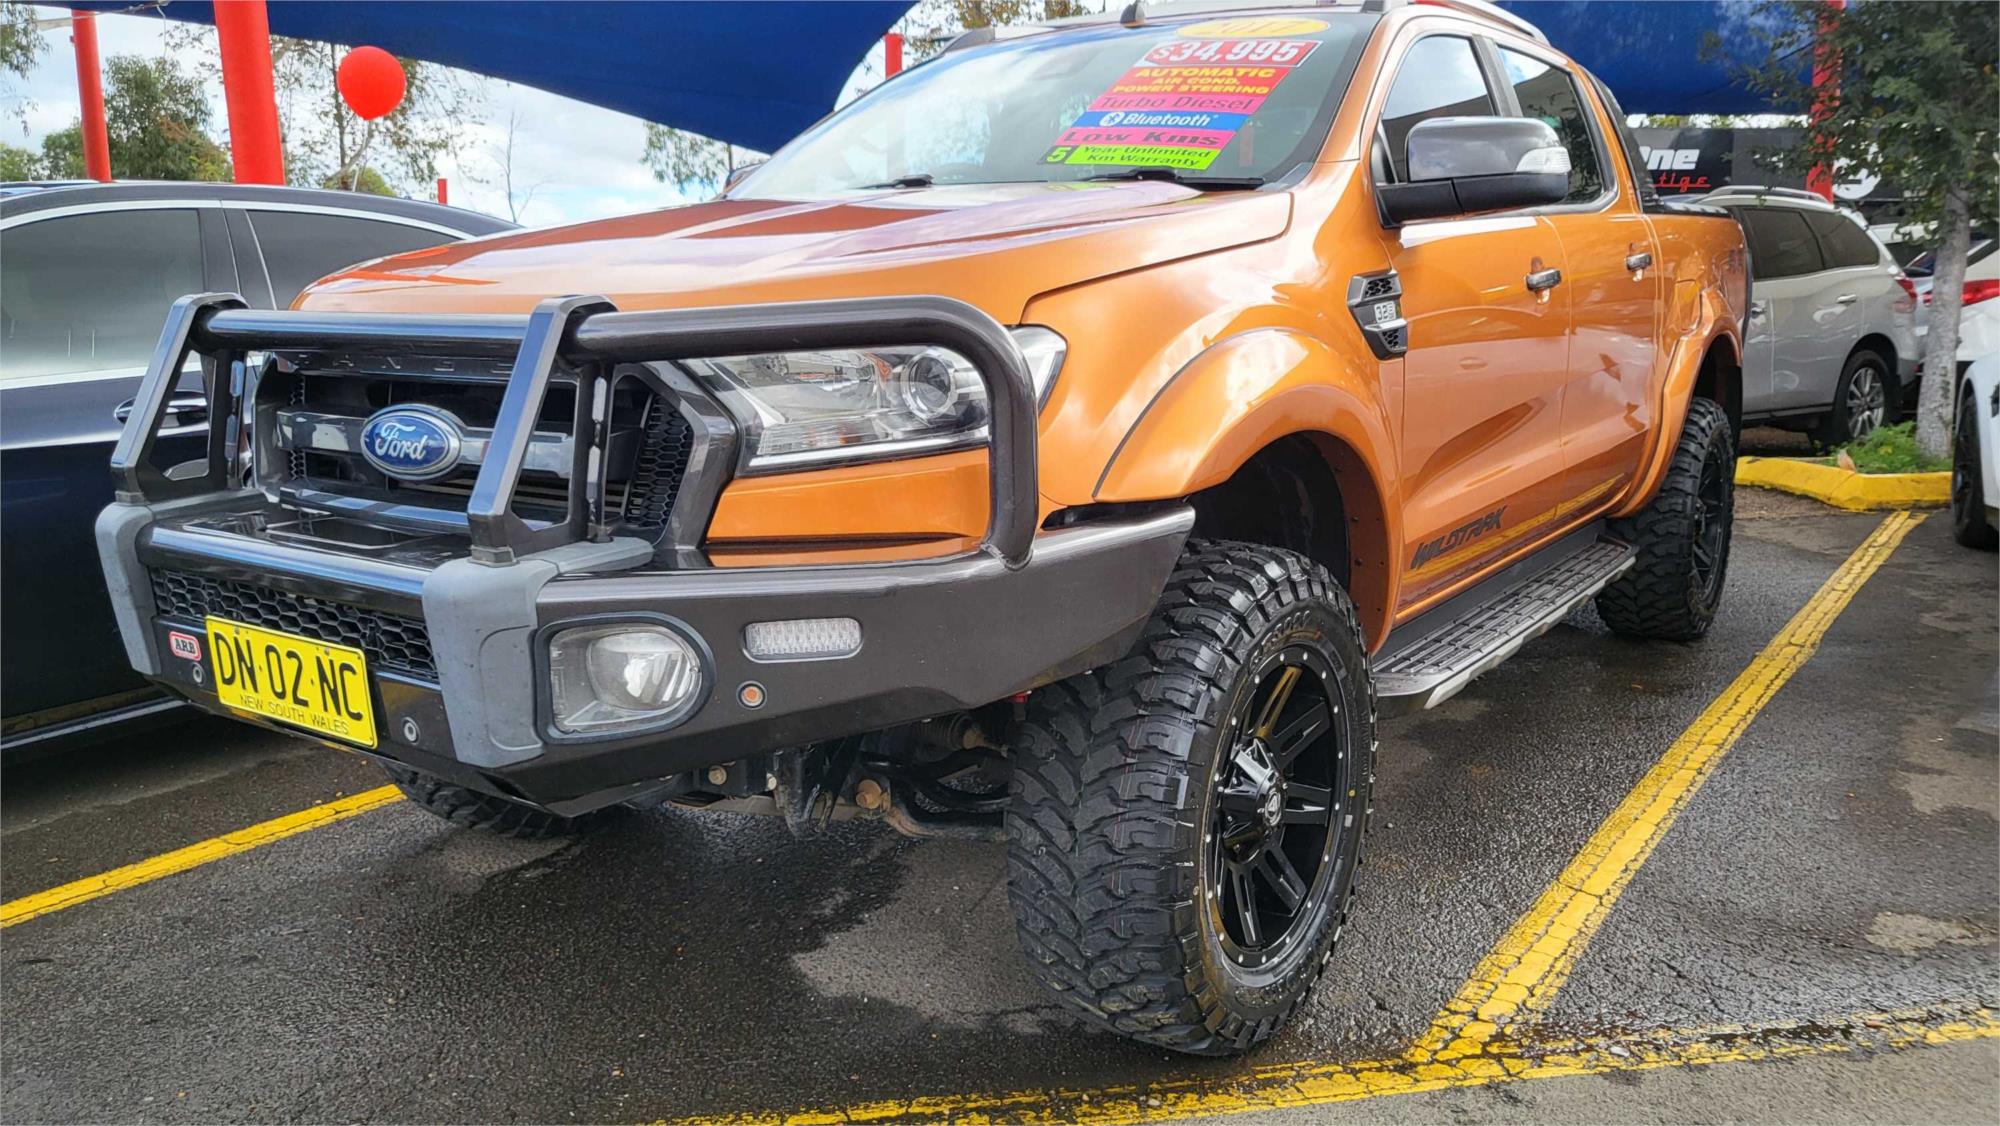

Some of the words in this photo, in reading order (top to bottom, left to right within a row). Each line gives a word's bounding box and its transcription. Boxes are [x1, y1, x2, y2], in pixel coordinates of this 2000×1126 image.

[1153, 41, 1306, 63] $34,995
[1135, 67, 1276, 78] AUTOMATIC
[1112, 85, 1174, 93] POWER
[1178, 85, 1269, 94] STEERING
[1101, 96, 1165, 108] Turbo
[1173, 96, 1254, 110] Diesel
[1122, 113, 1211, 127] Bluetooth
[1063, 131, 1131, 142] Low
[1142, 131, 1221, 146] Kms
[1046, 147, 1072, 163] 5
[1083, 146, 1121, 154] Year
[1124, 147, 1211, 158] Unlimited
[1087, 154, 1116, 162] Km
[1119, 154, 1201, 166] Warranty
[1658, 172, 1710, 193] tige
[374, 421, 428, 460] Ford
[1410, 505, 1508, 569] WILDTRAK
[175, 638, 196, 655] ARB
[240, 693, 264, 710] NEW
[268, 701, 305, 721] SOUTH
[310, 713, 349, 736] WALES
